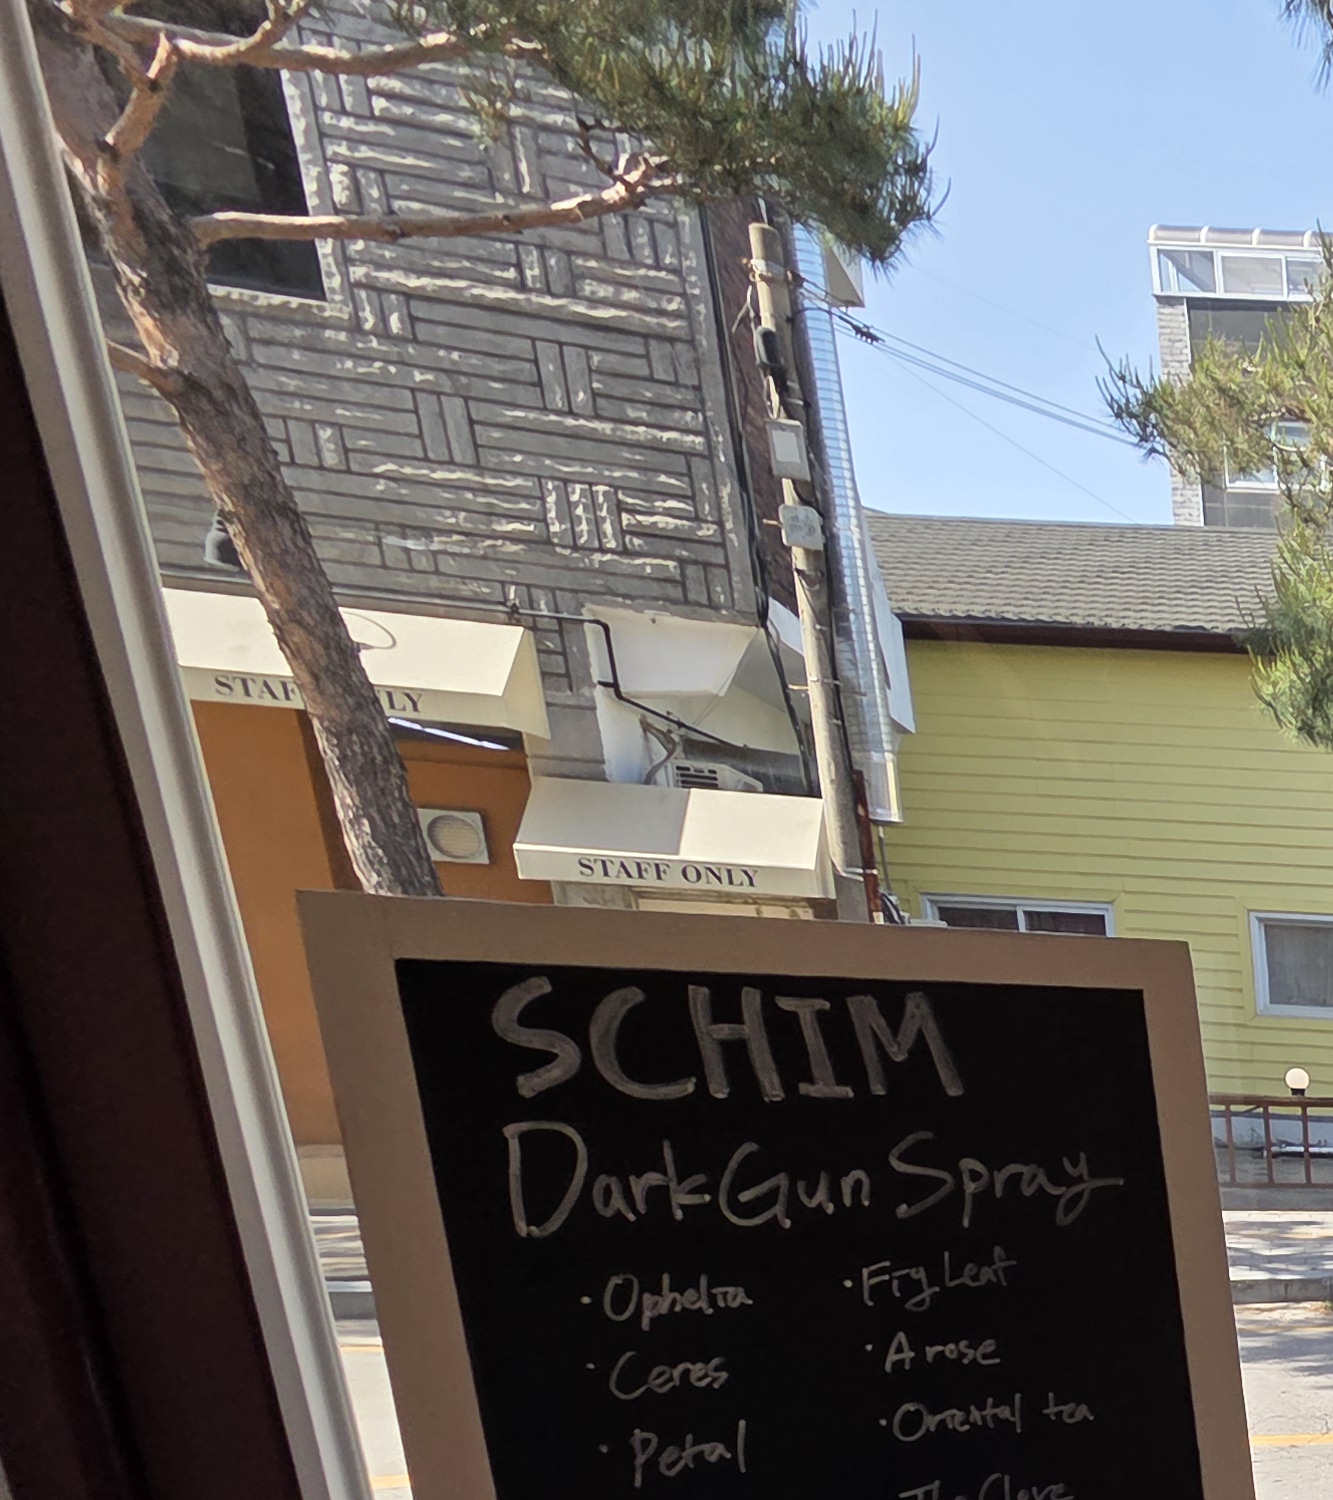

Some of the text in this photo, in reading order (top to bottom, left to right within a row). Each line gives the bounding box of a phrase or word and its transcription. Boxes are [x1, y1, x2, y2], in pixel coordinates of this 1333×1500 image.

[214, 674, 300, 702] STAF
[577, 857, 759, 888] STAFF ONLY
[491, 974, 966, 1104] SCHIM
[502, 1119, 1124, 1239] Dark Gun Spray
[943, 1245, 1018, 1287] Leaf
[602, 1272, 754, 1332] Ophelia
[608, 1350, 729, 1401] Ceres
[1042, 1392, 1095, 1424] tea
[629, 1419, 748, 1489] Petal
